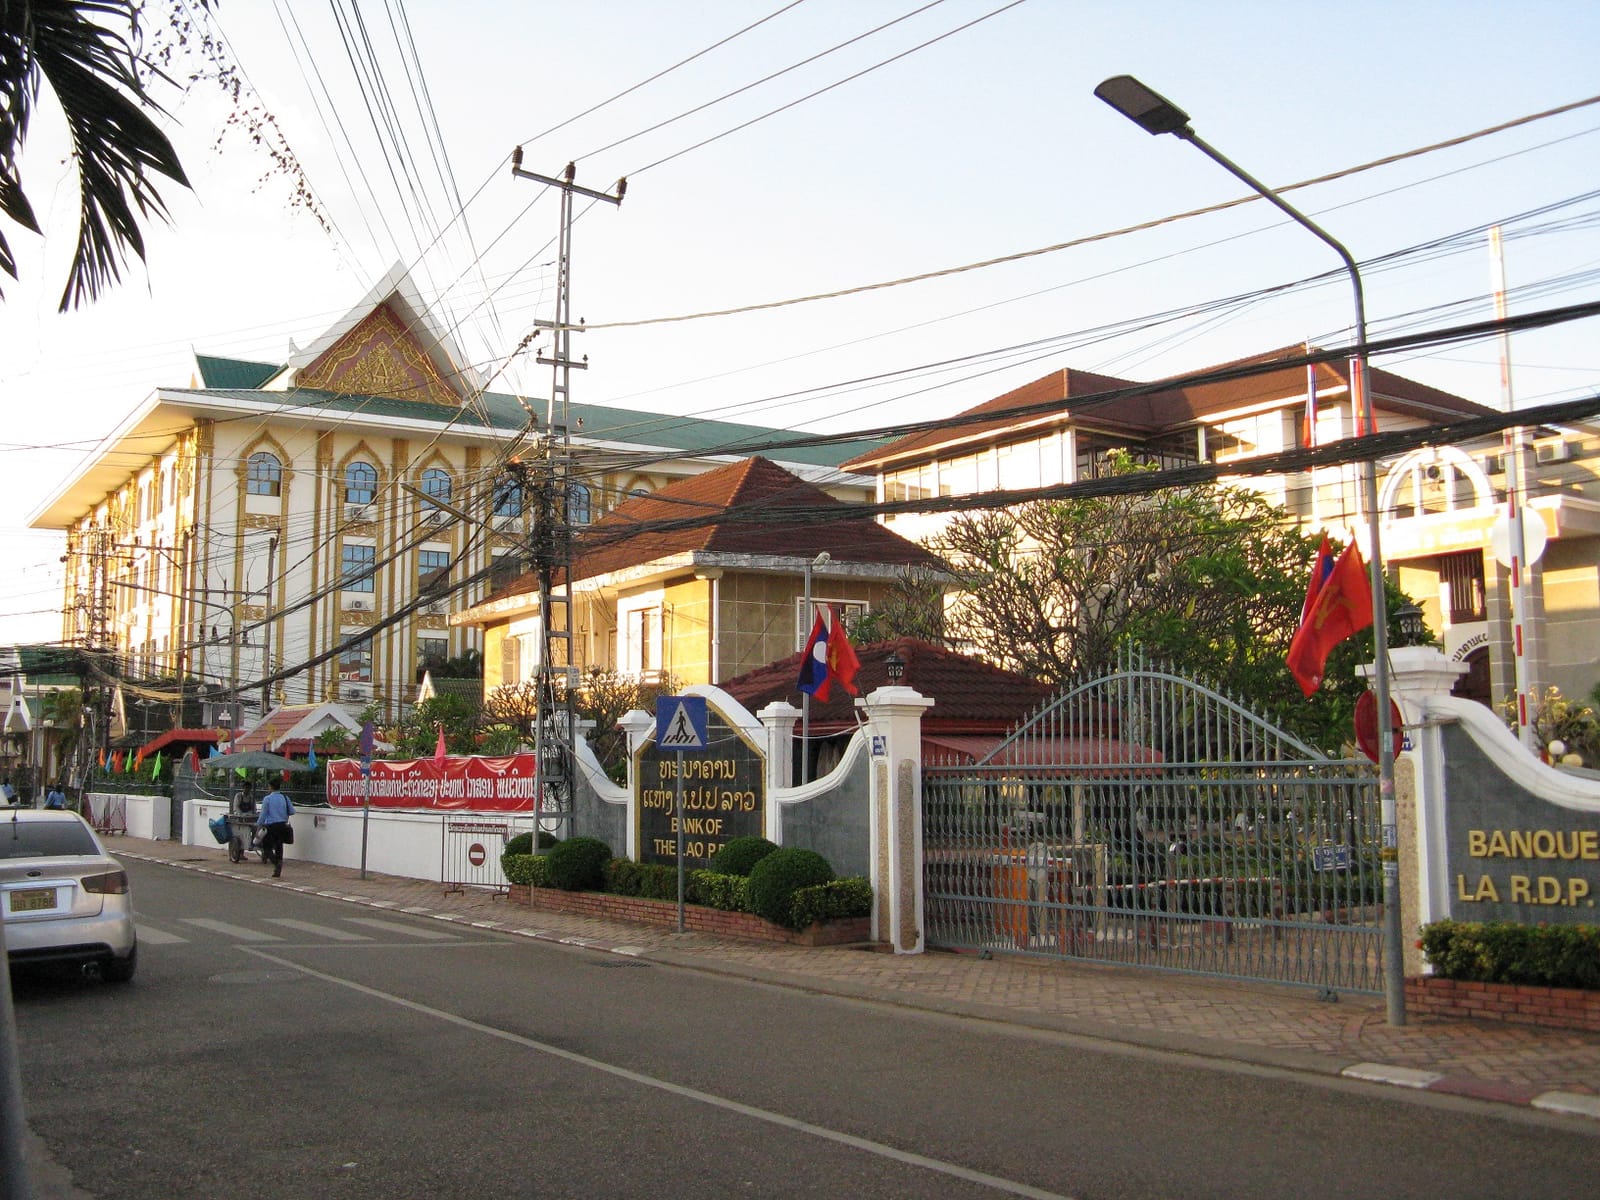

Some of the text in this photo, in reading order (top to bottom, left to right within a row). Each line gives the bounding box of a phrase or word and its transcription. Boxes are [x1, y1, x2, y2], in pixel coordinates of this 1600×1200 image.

[705, 818, 723, 836] OF
[653, 838, 676, 856] THE
[682, 842, 704, 858] AO
[1468, 829, 1600, 860] BANQUE
[1457, 873, 1500, 902] LA
